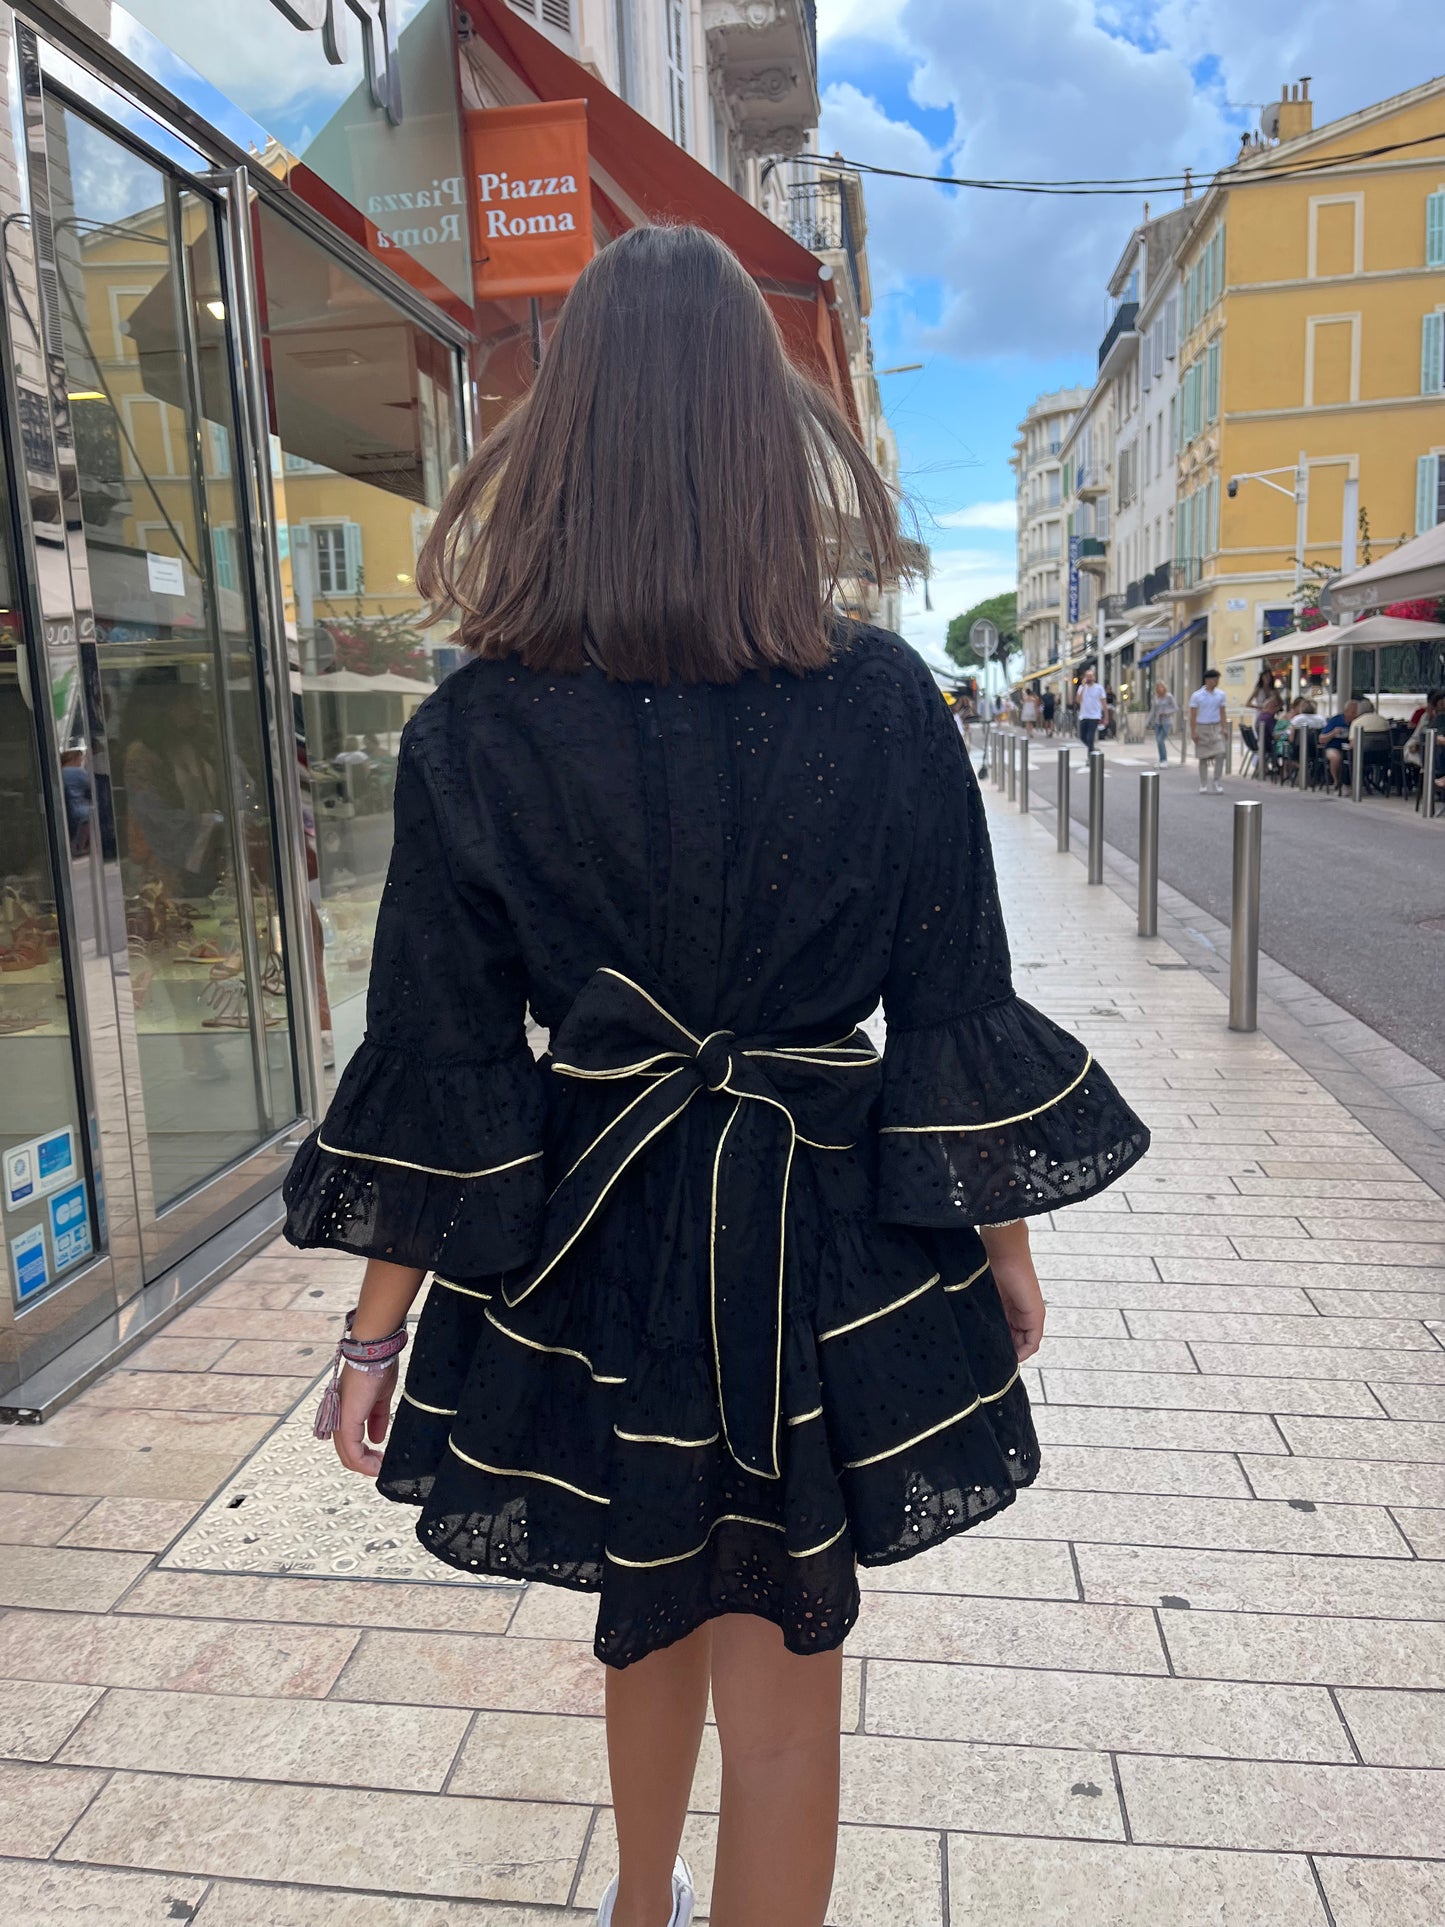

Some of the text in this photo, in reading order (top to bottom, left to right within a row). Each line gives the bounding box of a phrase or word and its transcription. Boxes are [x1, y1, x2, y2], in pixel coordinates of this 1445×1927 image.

[478, 172, 578, 202] Piazza
[486, 209, 576, 238] Roma
[1070, 585, 1078, 623] HOTEL
